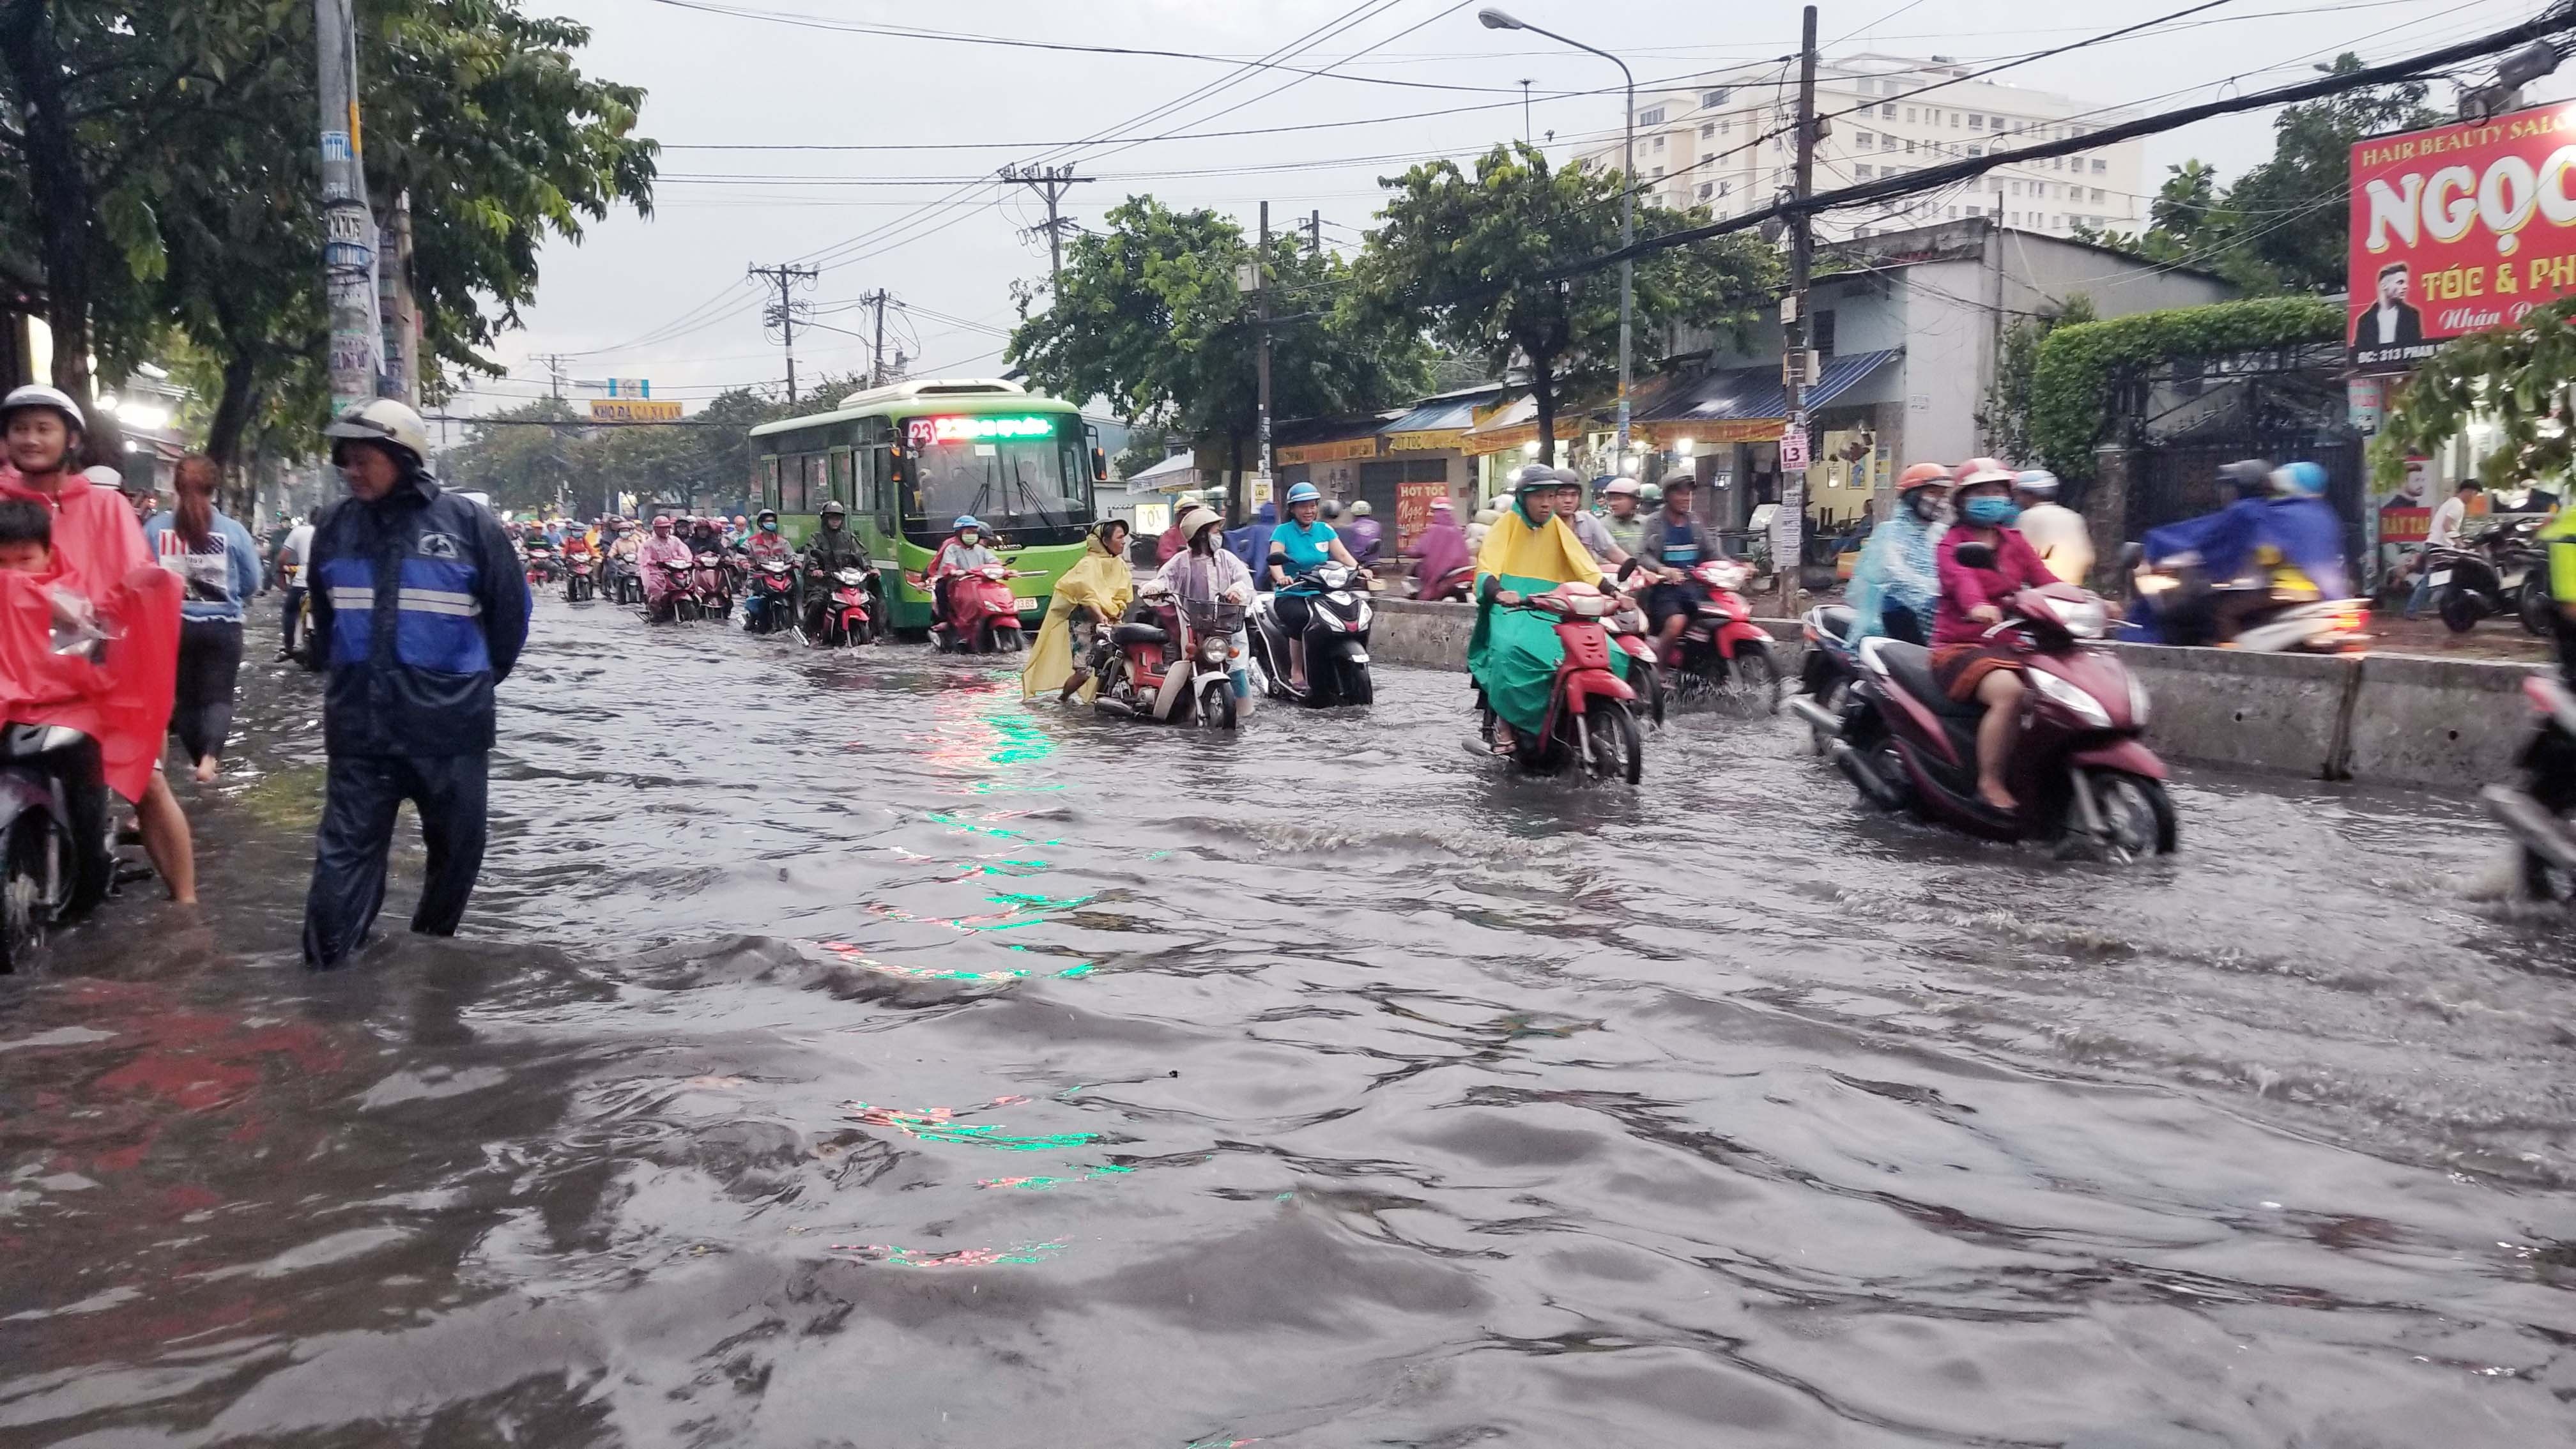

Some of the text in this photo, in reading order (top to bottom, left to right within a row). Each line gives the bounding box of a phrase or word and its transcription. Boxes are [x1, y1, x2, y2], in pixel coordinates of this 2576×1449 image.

[2363, 141, 2415, 167] HAIR
[2420, 124, 2506, 157] BEAUTY
[2366, 144, 2576, 257] NGỌC
[2421, 263, 2484, 302] TÓC
[2496, 262, 2520, 295] &
[2379, 348, 2402, 362] 313
[910, 423, 933, 444] 23
[1783, 447, 1800, 463] 13
